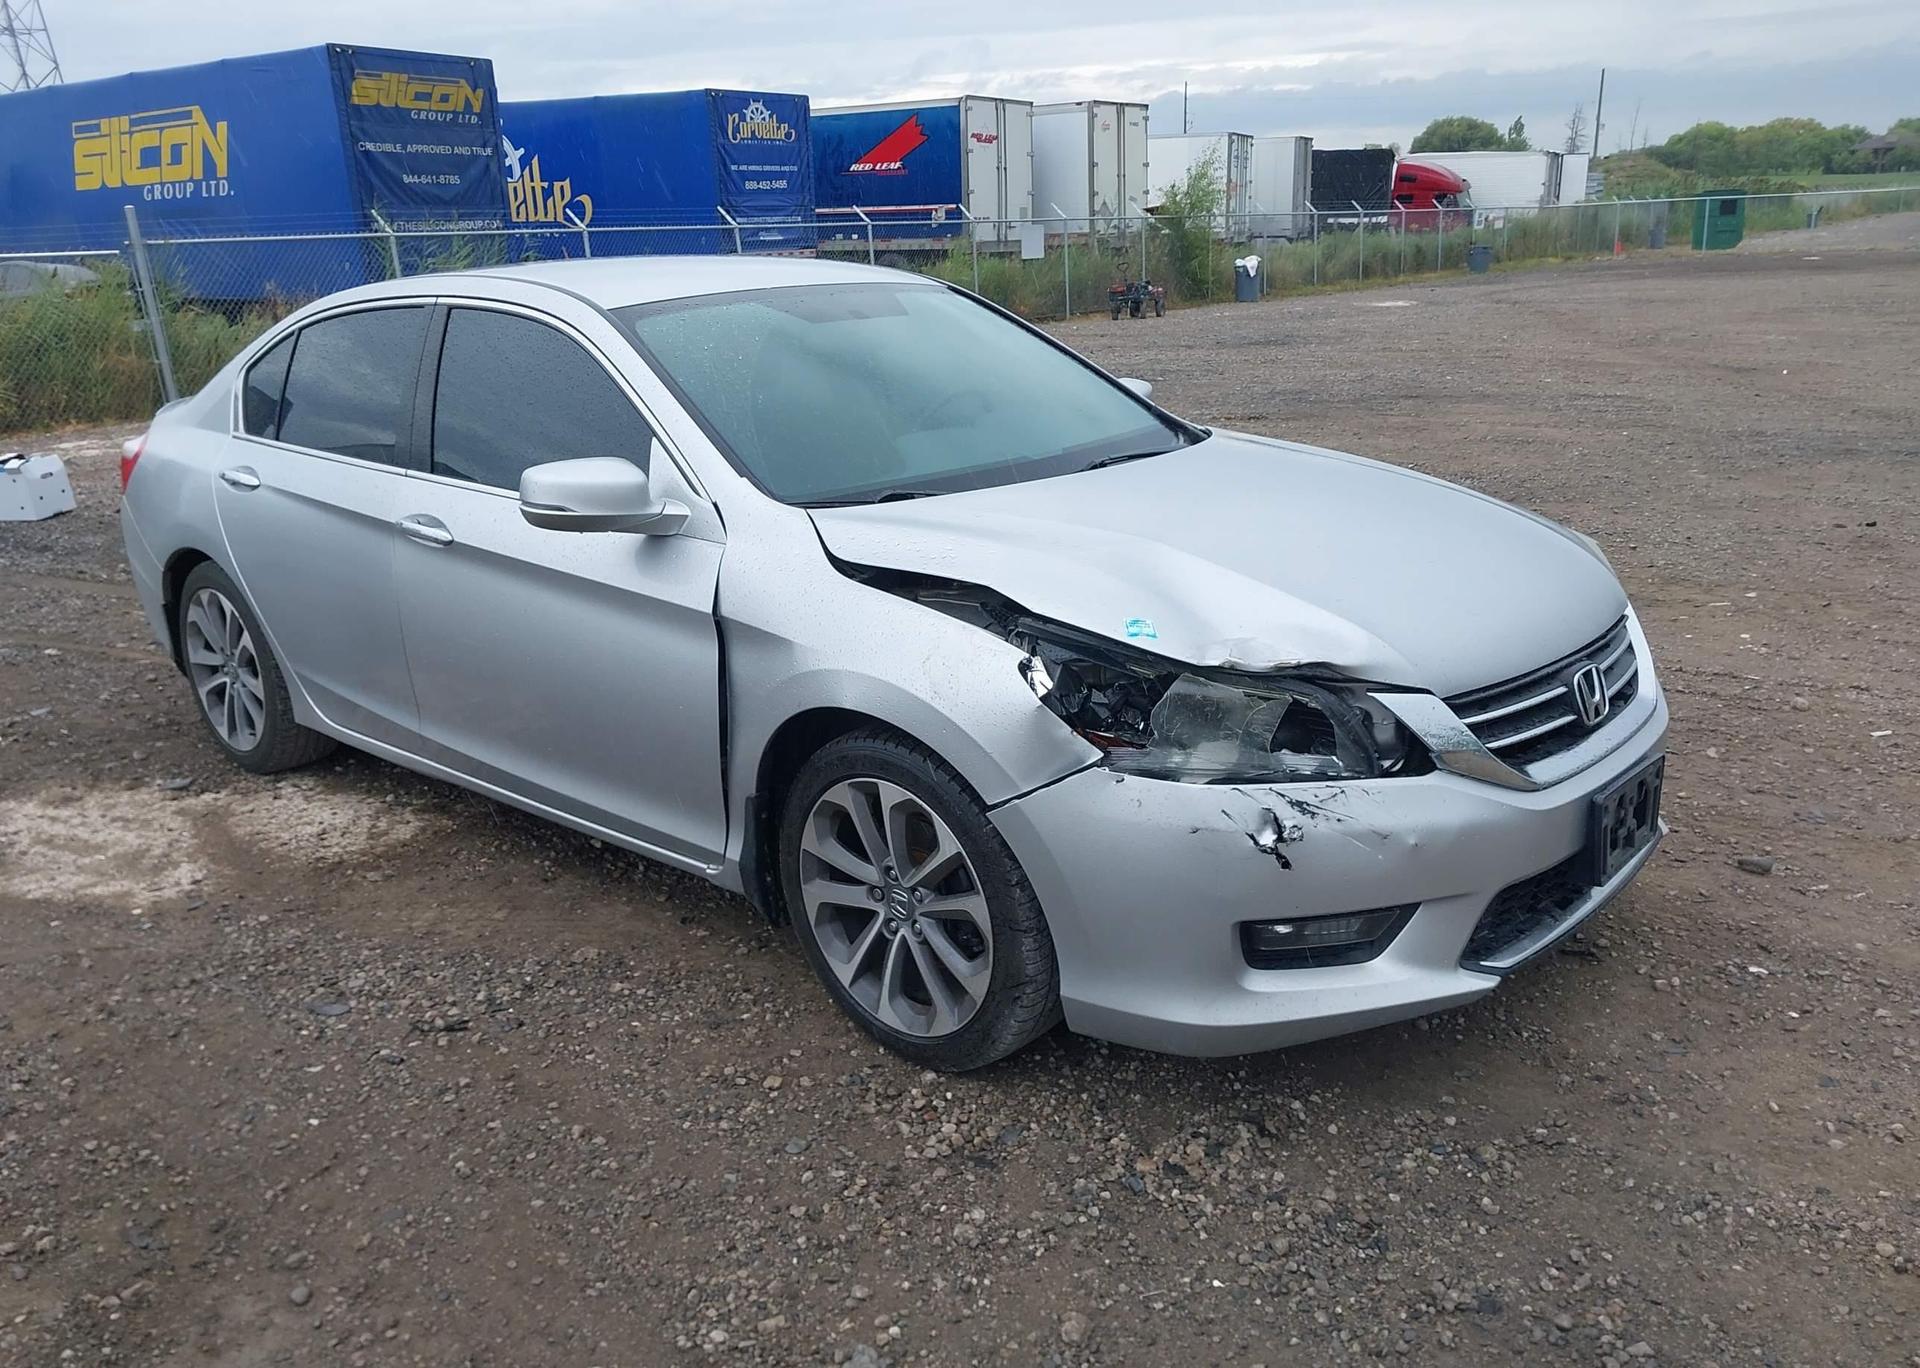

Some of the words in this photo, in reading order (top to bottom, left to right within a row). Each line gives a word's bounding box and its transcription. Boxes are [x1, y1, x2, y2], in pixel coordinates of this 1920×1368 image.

[411, 109, 453, 122] GROUP
[458, 115, 482, 125] LTD.
[358, 141, 405, 154] CREDIBLE,
[406, 144, 452, 154] APPROVED
[453, 146, 471, 155] AND
[473, 147, 493, 156] TRUE
[849, 163, 873, 171] RED
[874, 161, 904, 170] LEAF
[143, 181, 195, 201] GROUP
[201, 179, 234, 198] LTD.
